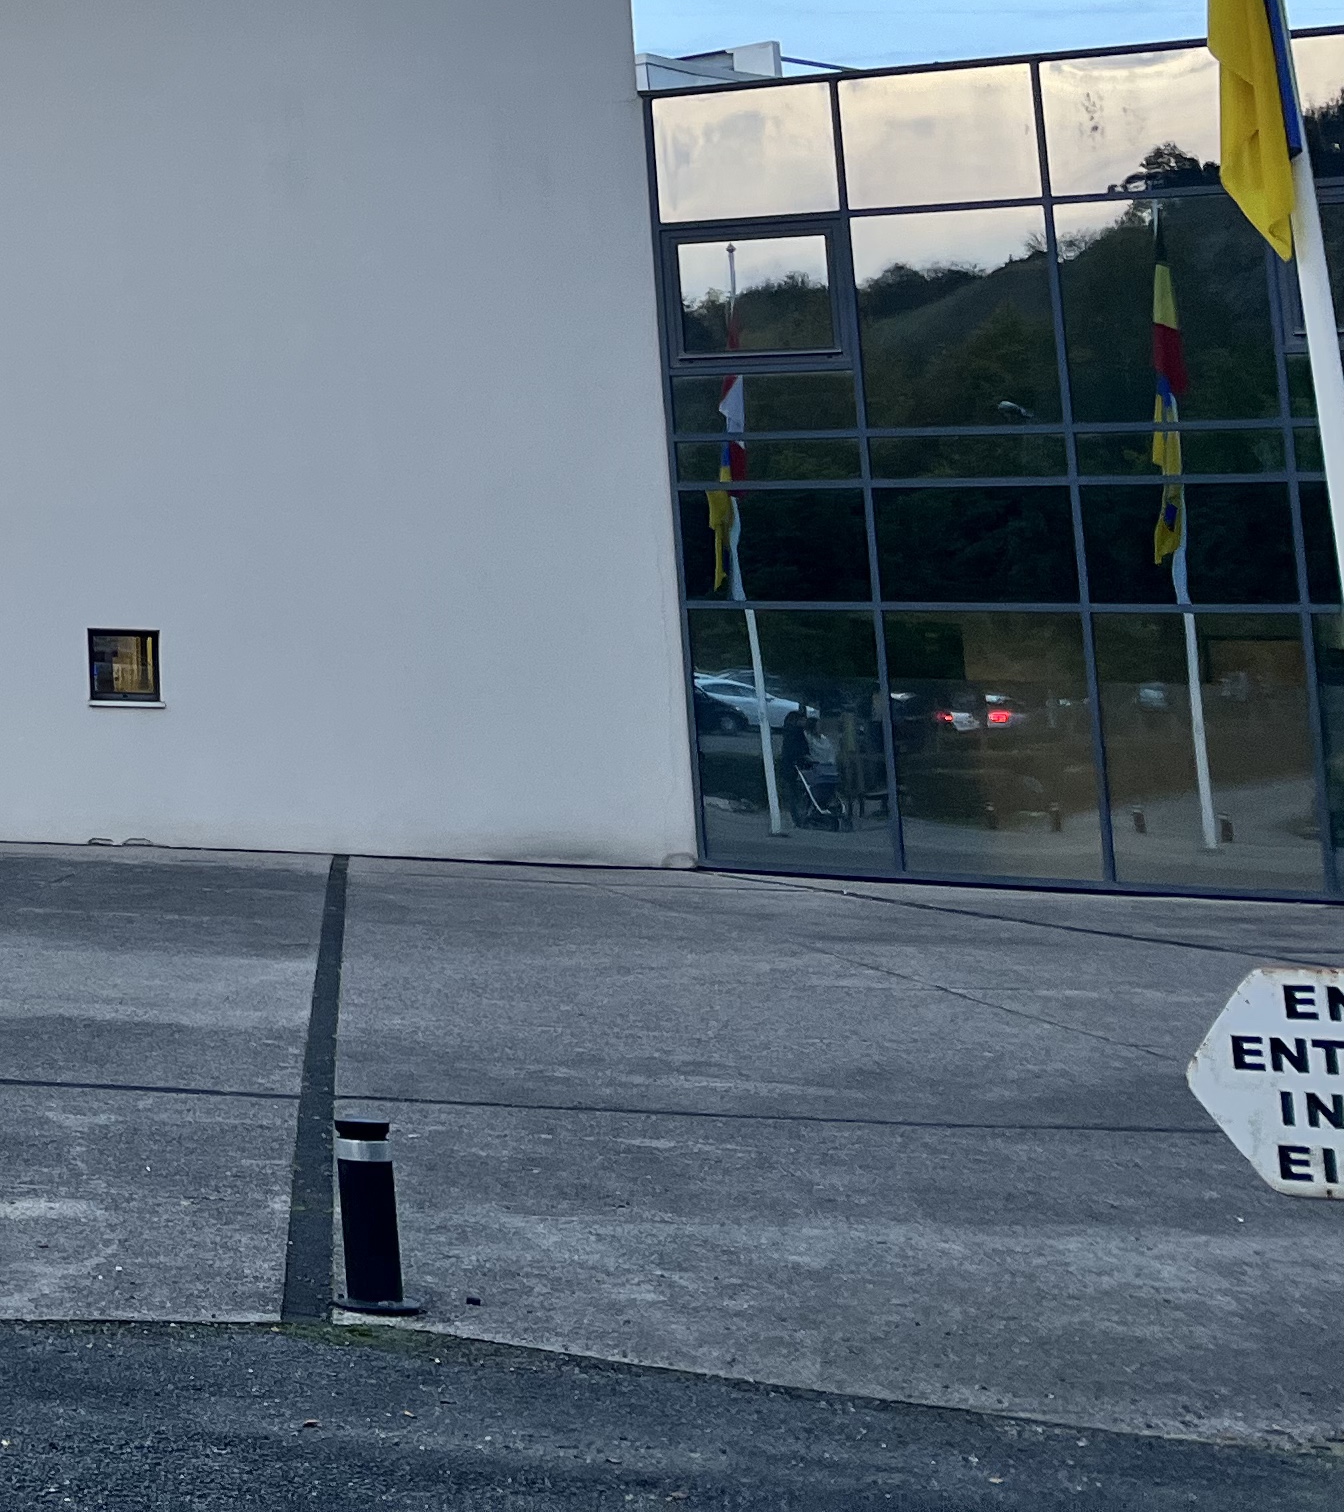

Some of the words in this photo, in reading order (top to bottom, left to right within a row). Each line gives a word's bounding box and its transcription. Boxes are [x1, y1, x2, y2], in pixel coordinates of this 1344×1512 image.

[1231, 1035, 1344, 1075] ENT
[1280, 1091, 1344, 1129] IN
[1278, 1144, 1339, 1184] EI
